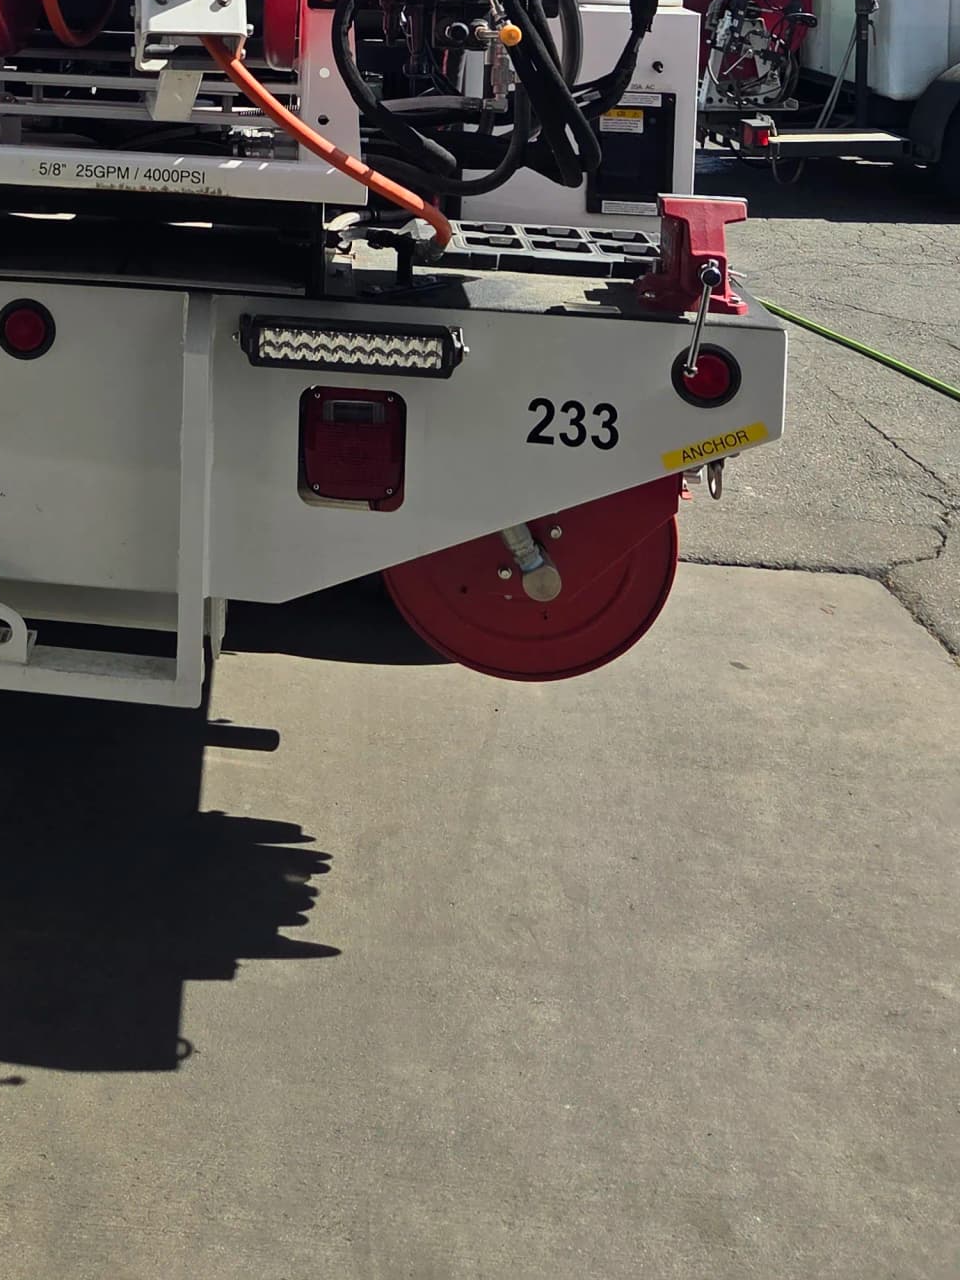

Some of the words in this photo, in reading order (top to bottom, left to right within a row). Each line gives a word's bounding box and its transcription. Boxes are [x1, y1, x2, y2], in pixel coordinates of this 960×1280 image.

[39, 162, 67, 176] 5/8"
[75, 163, 130, 180] 25GPM
[134, 167, 140, 180] /
[143, 168, 206, 184] 4000PSI
[526, 397, 619, 450] 233
[681, 430, 749, 462] ANCHOR
